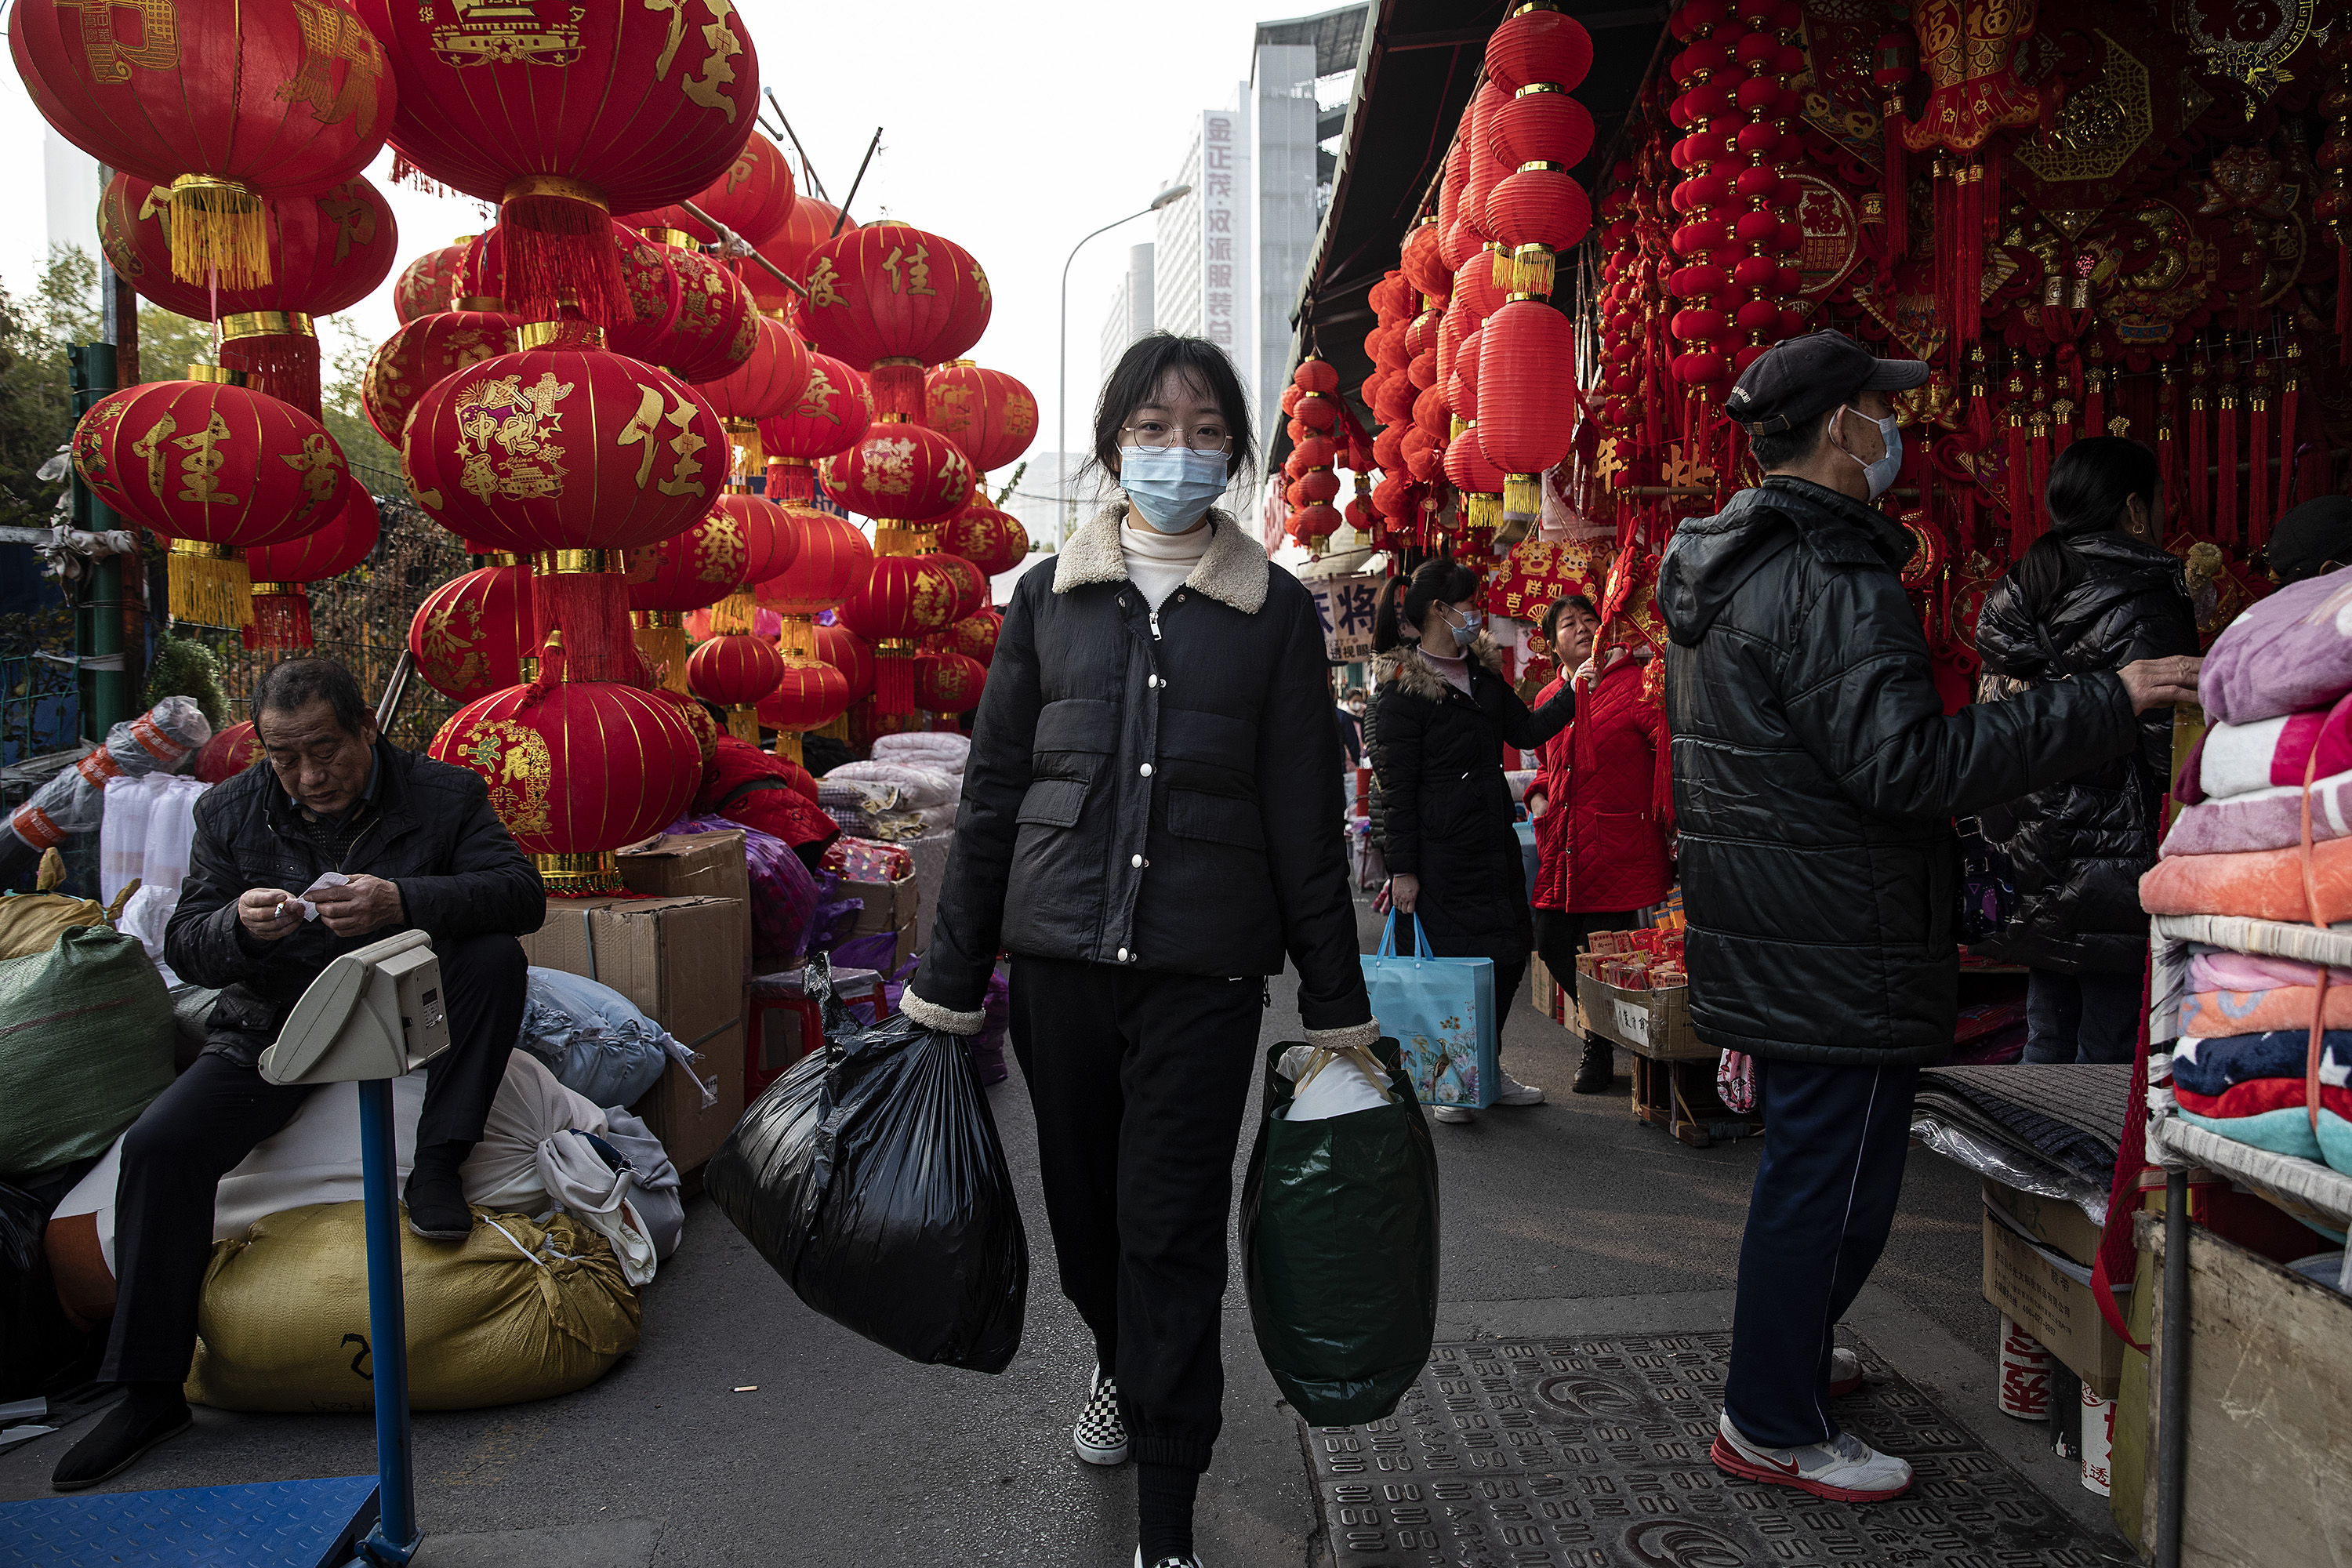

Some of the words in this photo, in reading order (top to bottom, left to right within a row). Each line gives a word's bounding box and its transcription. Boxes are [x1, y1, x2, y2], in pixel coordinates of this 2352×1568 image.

[1972, 347, 1985, 361] 福
[2287, 343, 2302, 358] 福
[2009, 376, 2024, 392] 福
